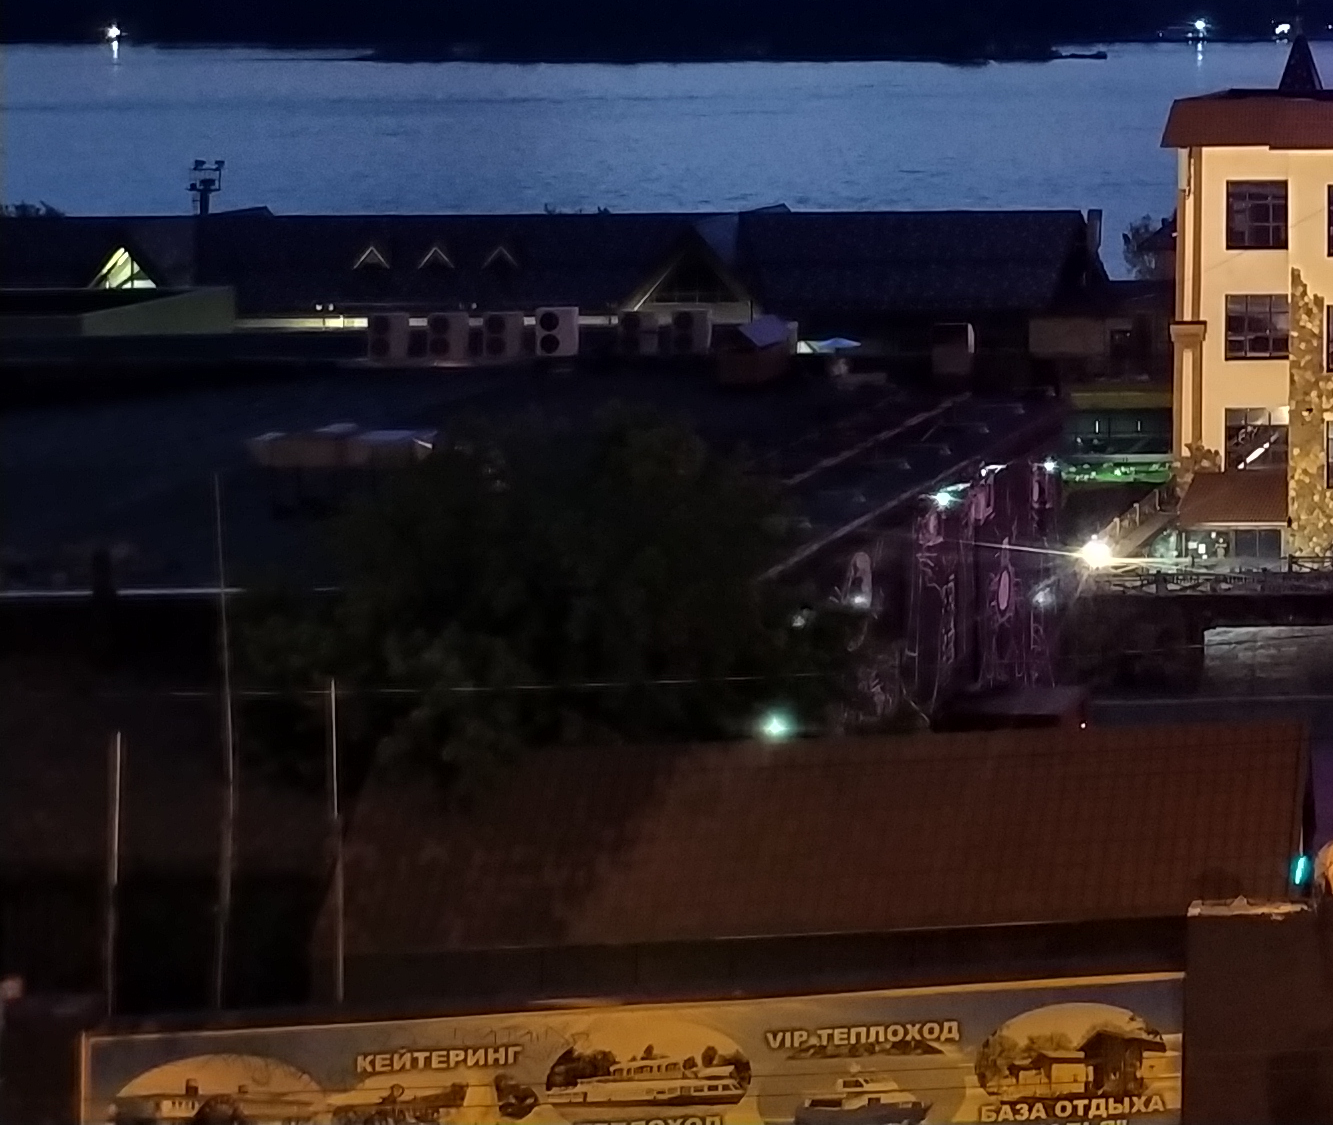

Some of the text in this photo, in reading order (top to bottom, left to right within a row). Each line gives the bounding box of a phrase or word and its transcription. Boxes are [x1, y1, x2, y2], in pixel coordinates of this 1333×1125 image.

[765, 1020, 961, 1049] VIP ТЕПЛОХОД
[356, 1045, 524, 1074] КЕЙТЕРИНГ
[979, 1095, 1166, 1123] БАЗА ОТДЫХА
